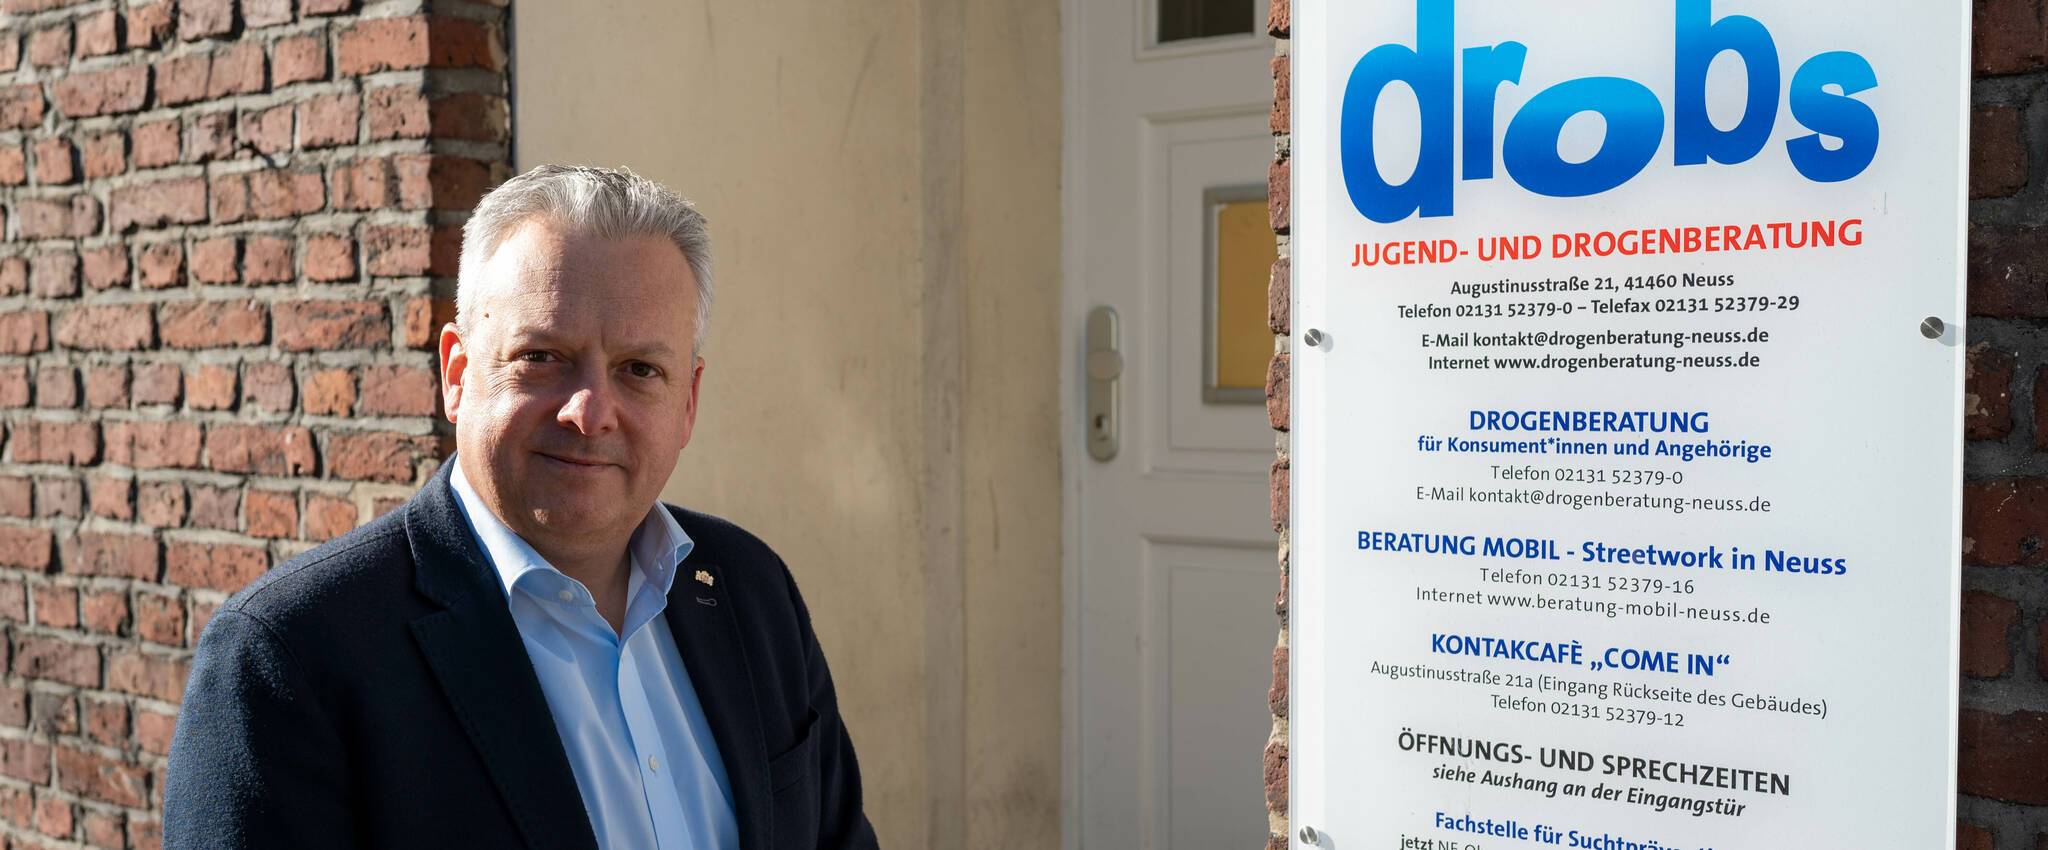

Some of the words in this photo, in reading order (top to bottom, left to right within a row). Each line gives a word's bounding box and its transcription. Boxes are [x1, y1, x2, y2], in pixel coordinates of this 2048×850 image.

[1341, 0, 1879, 223] drobs
[1352, 240, 1468, 267] JUGEND-
[1478, 235, 1541, 261] UND
[1552, 219, 1862, 258] DROGENBERATUNG
[1451, 276, 1589, 298] Augustinusstraße
[1595, 277, 1619, 293] 21,
[1624, 274, 1677, 291] 41460
[1683, 273, 1734, 287] Neuss
[1398, 304, 1451, 318] Telefon
[1456, 304, 1502, 318] 02131
[1508, 302, 1572, 317] 52379-0
[1591, 298, 1650, 313] Telefax
[1655, 298, 1708, 313] 02131
[1715, 296, 1799, 312] 52379-29
[1422, 332, 1468, 347] E-Mail
[1474, 327, 1768, 349] kontakt@drogenberatung-neuss.de
[1429, 356, 1489, 369] Internet
[1494, 352, 1760, 373] www.drogenberatung-neuss.de
[1470, 411, 1708, 433] DROGENBERATUNG
[1417, 435, 1442, 451] für
[1614, 439, 1649, 456] und
[1655, 440, 1771, 463] Angehörige
[1491, 465, 1549, 480] Telefon
[1555, 469, 1606, 483] 02131
[1612, 470, 1682, 485] 52379-0
[1417, 487, 1463, 501] E-Mail
[1470, 487, 1770, 513] kontakt@drogenberatung-neuss.de
[1358, 531, 1475, 555] BERATUNG
[1483, 537, 1560, 560] MOBIL
[1583, 541, 1723, 568] Streetwork
[1732, 547, 1755, 570] in
[1765, 550, 1846, 575] Neuss
[1480, 568, 1542, 584] Telefon
[1548, 573, 1601, 589] 02131
[1608, 577, 1694, 594] 52379-16
[1417, 587, 1482, 604] Internet
[1488, 594, 1770, 624] www.beratung-mobil-neuss.de
[1432, 633, 1582, 665] KONTAKCAFÈ
[1371, 661, 1500, 685] Augustinusstraße
[1506, 674, 1532, 688] 21a
[1539, 674, 1607, 700] (Eingang
[1614, 682, 1692, 703] Rückseite
[1697, 690, 1726, 706] des
[1732, 693, 1827, 719] Gebäudes)
[1491, 694, 1545, 712] Telefon
[1551, 702, 1600, 718] 02131
[1606, 707, 1684, 726] 52379-12
[1398, 727, 1532, 764] ÖFFNUNGS-
[1540, 747, 1594, 772] UND
[1602, 755, 1789, 797] SPRECHZEITEN
[1433, 764, 1476, 783] siehe
[1480, 770, 1558, 798] Aushang
[1563, 784, 1586, 797] an
[1591, 783, 1622, 801] der
[1627, 787, 1746, 817] Eingangstür
[1400, 834, 1433, 850] jetzt
[1436, 812, 1528, 840] Fachstelle
[1533, 824, 1563, 845] für
